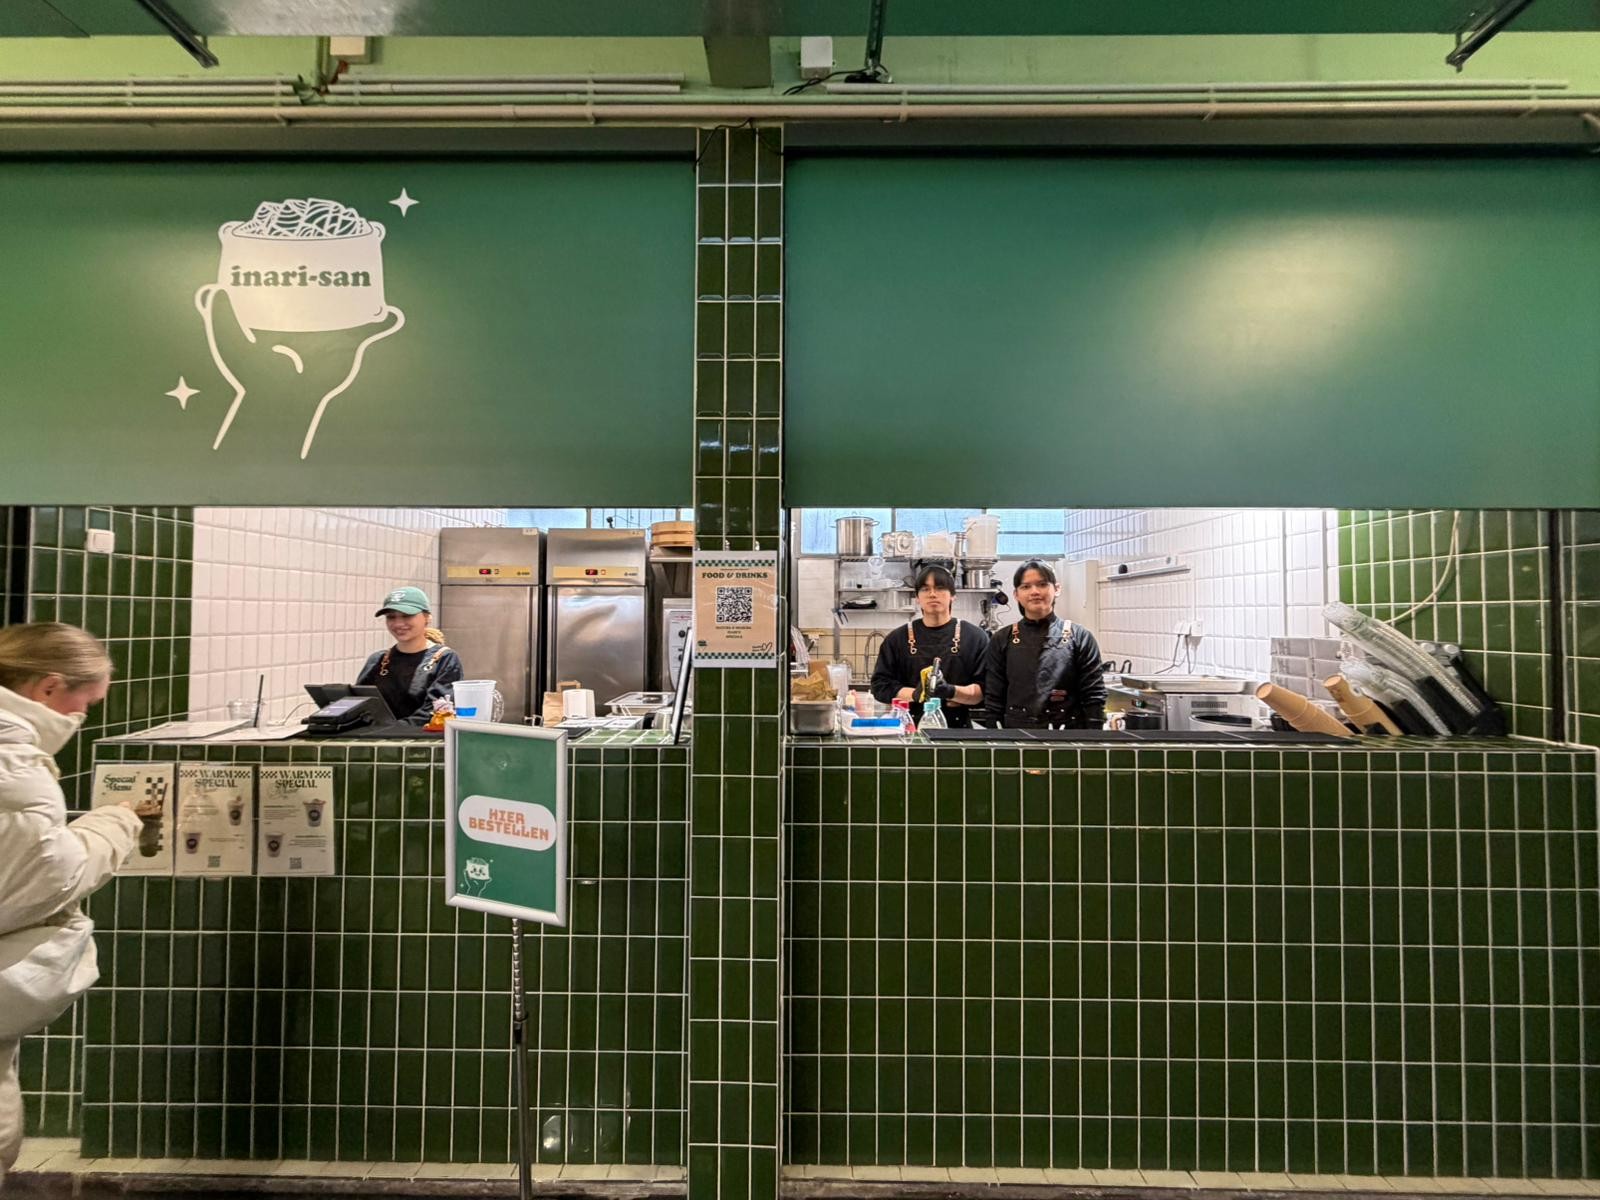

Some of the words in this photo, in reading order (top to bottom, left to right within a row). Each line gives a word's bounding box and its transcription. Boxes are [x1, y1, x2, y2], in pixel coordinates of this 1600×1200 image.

[231, 265, 371, 287] inari-san
[199, 770, 233, 779] WARM
[279, 770, 313, 779] WARM
[195, 778, 238, 788] SPECIAL
[275, 779, 318, 789] SPECIAL
[488, 808, 525, 825] HIER
[469, 817, 550, 841] BESTELLEN
